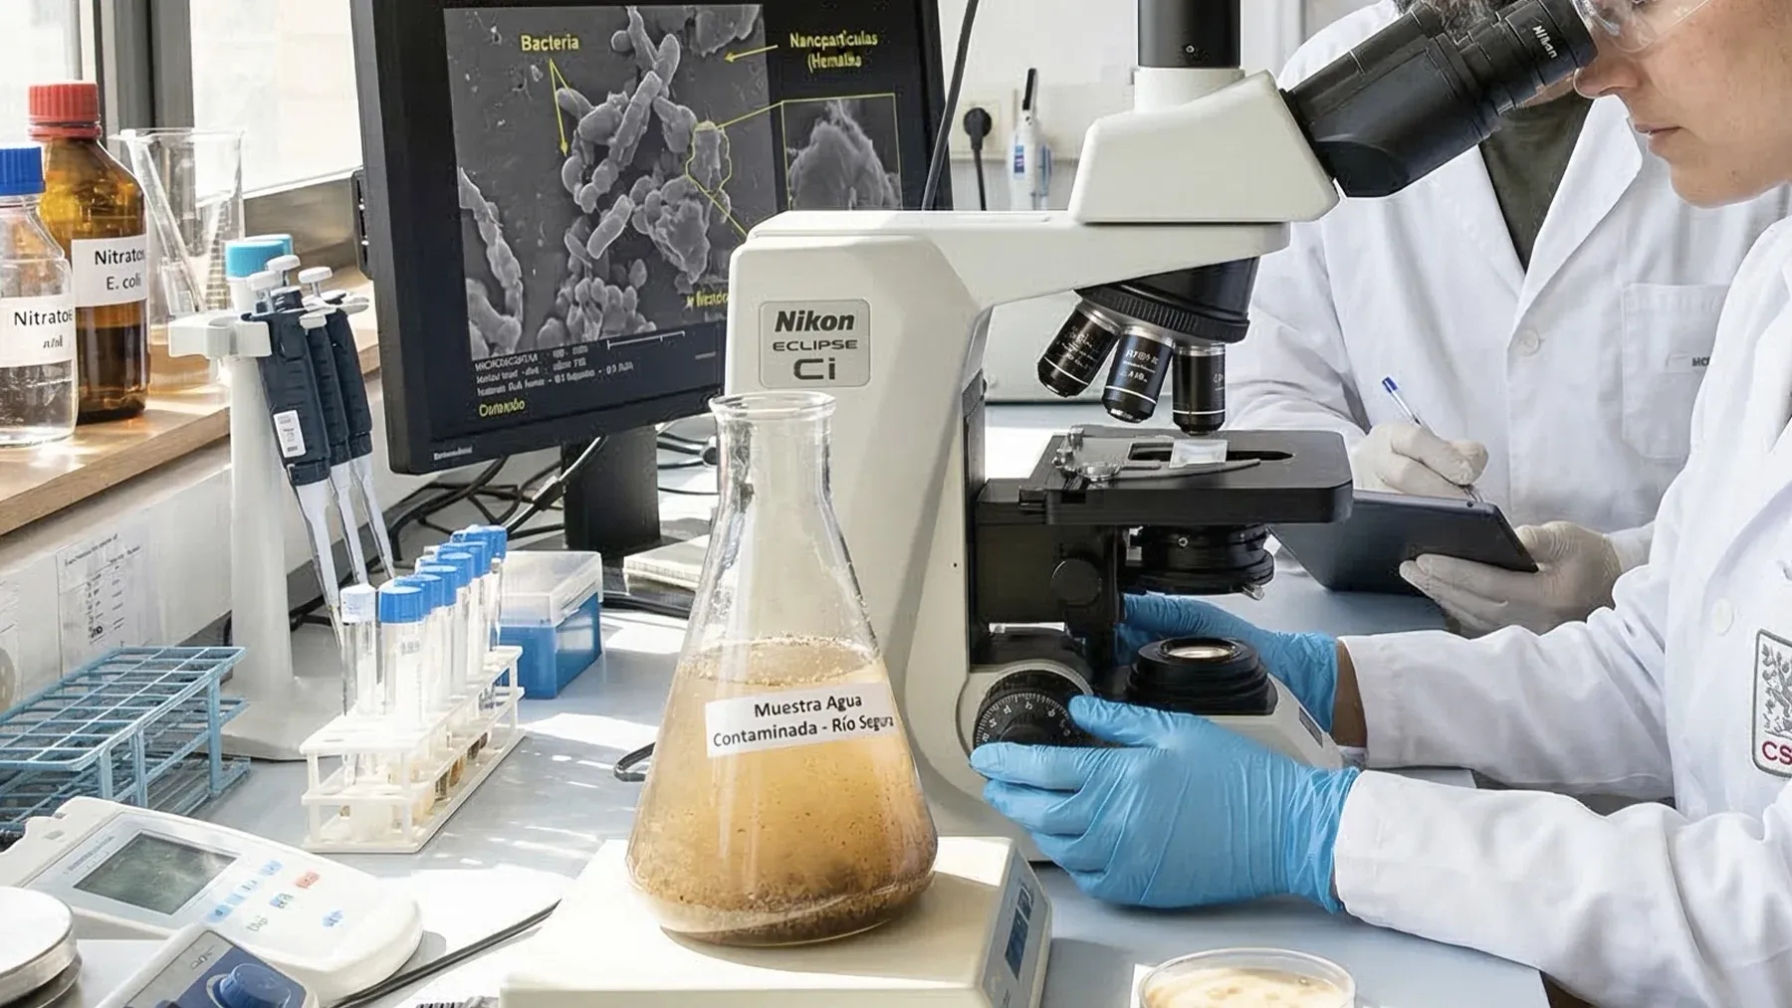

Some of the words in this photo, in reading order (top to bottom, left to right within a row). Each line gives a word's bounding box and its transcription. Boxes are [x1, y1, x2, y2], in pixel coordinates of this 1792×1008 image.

[520, 34, 580, 51] Bacteria
[106, 276, 119, 290] E.
[775, 310, 855, 332] Nikon
[772, 339, 858, 352] ECLIPSE
[793, 357, 836, 380] Ci
[754, 699, 822, 718] Muestra
[826, 695, 862, 712] Agua
[713, 721, 818, 747] Contaminada
[832, 714, 856, 733] Río
[1761, 741, 1792, 766] CS
